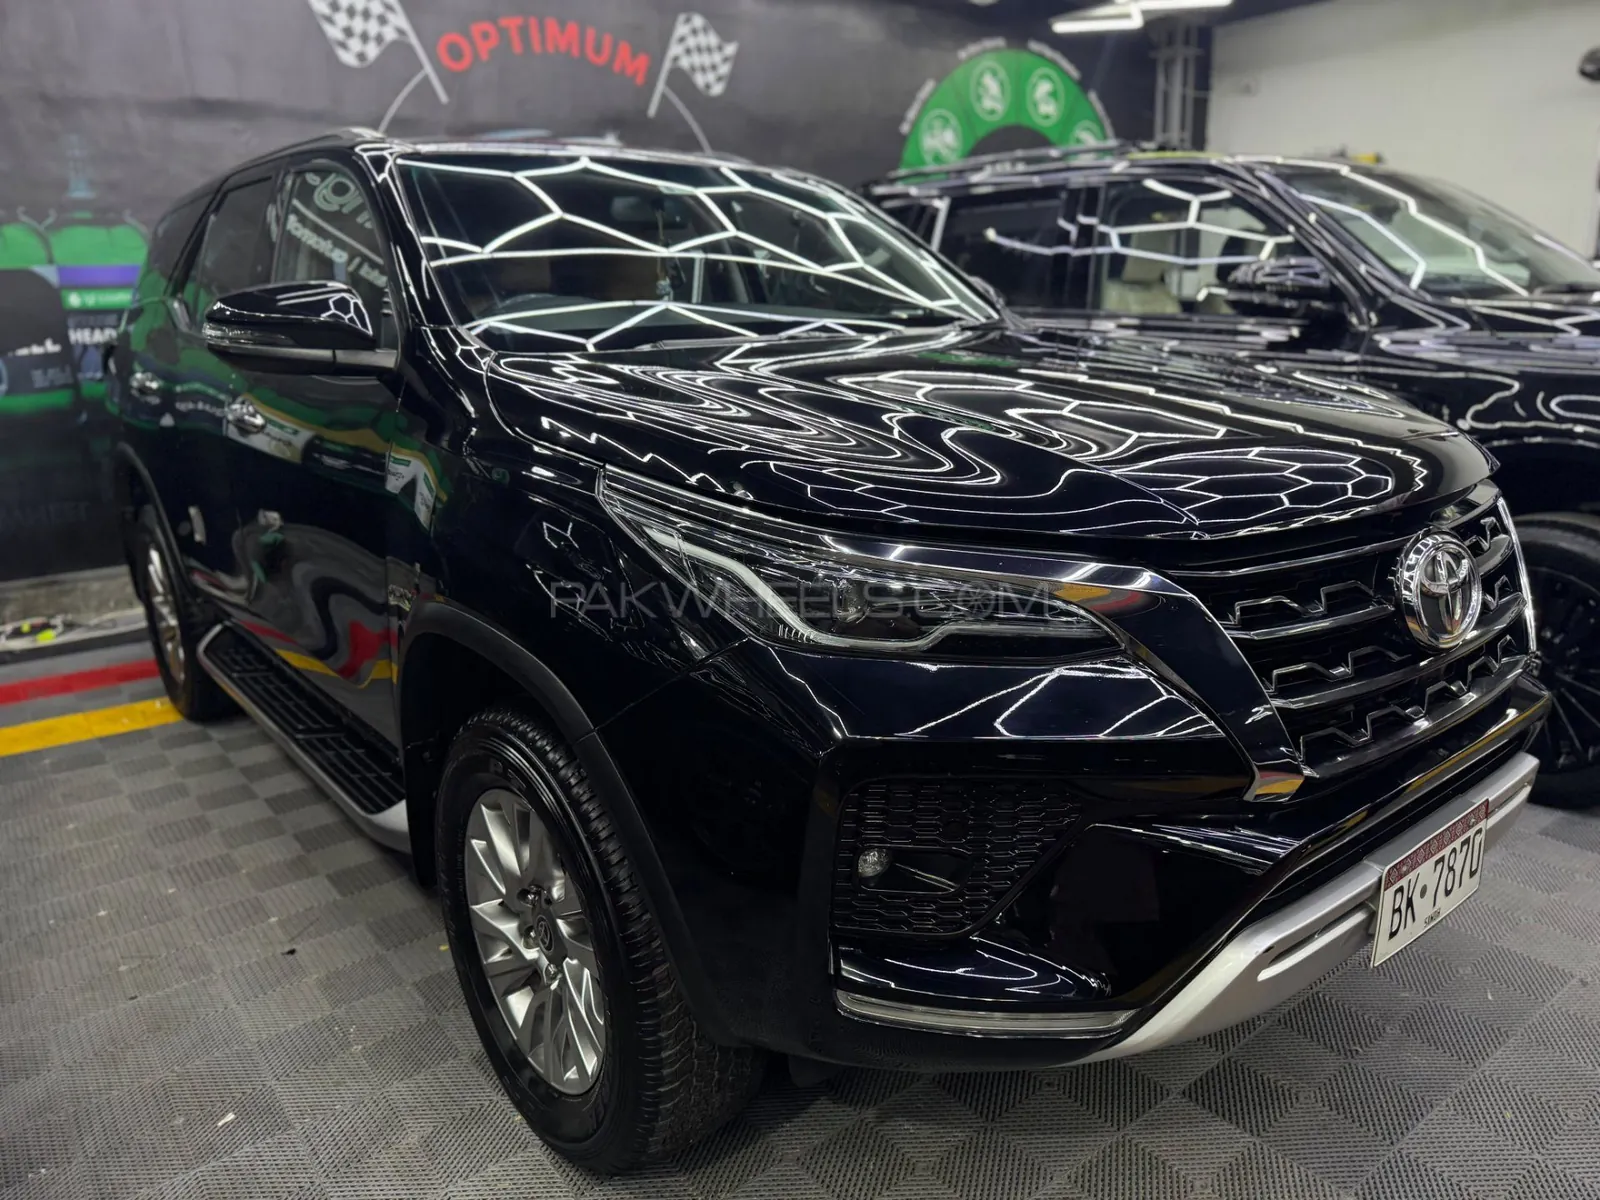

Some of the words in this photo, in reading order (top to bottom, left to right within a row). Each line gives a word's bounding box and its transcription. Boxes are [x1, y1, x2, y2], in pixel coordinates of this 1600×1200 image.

[437, 16, 650, 86] OPTIMUM
[1388, 872, 1420, 941] BK
[1432, 828, 1483, 908] 7870
